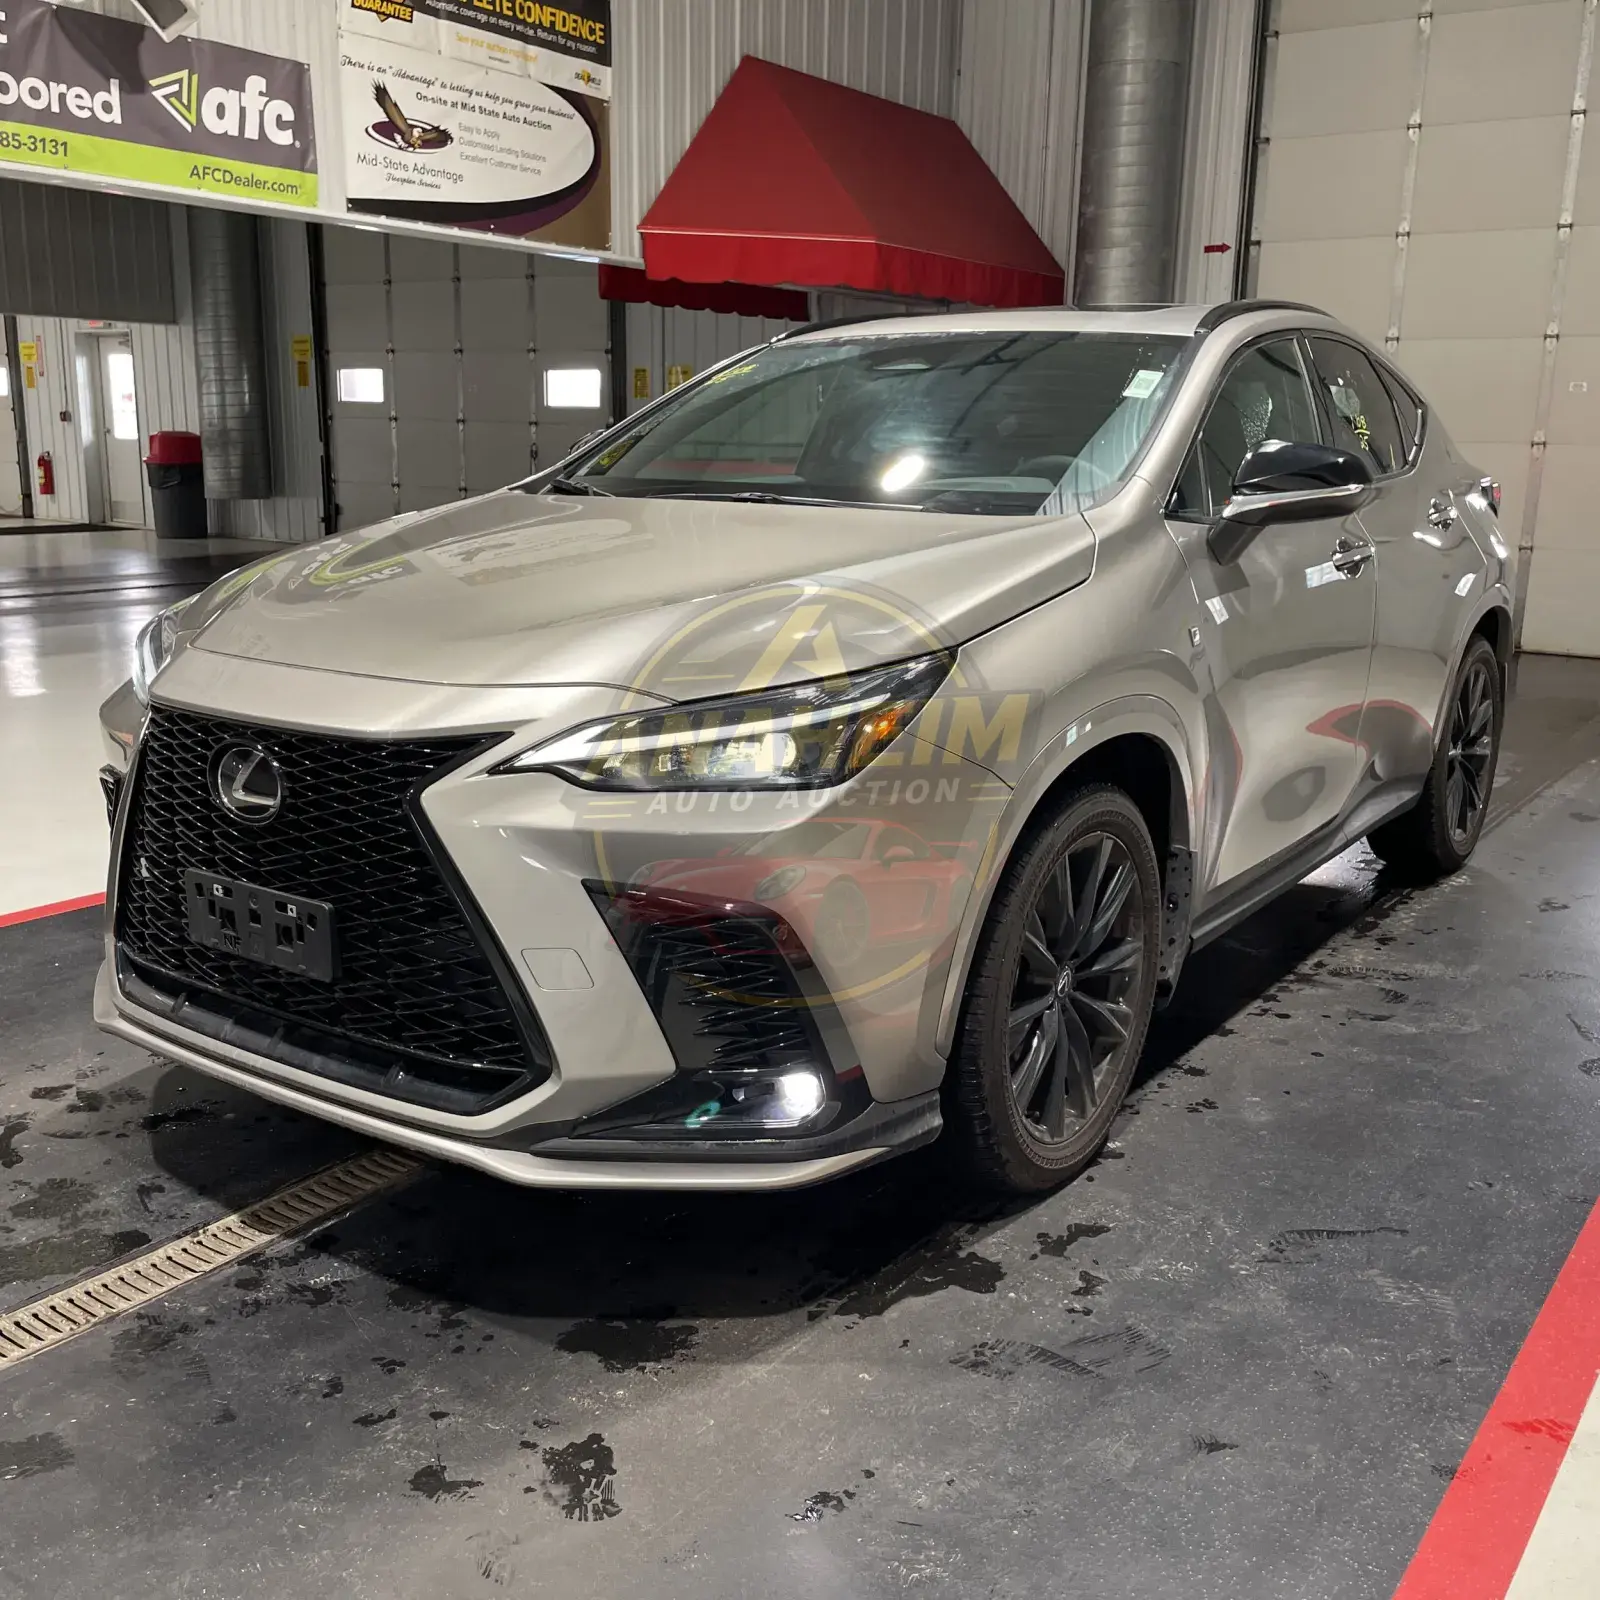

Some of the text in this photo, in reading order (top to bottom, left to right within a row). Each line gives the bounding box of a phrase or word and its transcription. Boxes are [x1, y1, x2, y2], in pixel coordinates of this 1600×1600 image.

[489, 16, 497, 24] on
[515, 0, 605, 44] CONFIDENCE
[340, 55, 365, 70] There
[367, 62, 374, 72] is
[376, 66, 387, 74] an
[440, 80, 447, 89] to
[449, 83, 474, 98] letting
[475, 90, 483, 98] us
[485, 90, 500, 102] help
[501, 96, 513, 107] you
[202, 75, 295, 146] afc
[416, 92, 552, 131] On-site at Mid State Auto Auction
[0, 131, 68, 157] 85-3131
[459, 122, 500, 140] Easy to Apply
[356, 153, 464, 184] Mid-State Advantage
[489, 157, 518, 171] Customer
[190, 165, 298, 195] AFCDealer.com
[417, 179, 441, 190] Services
